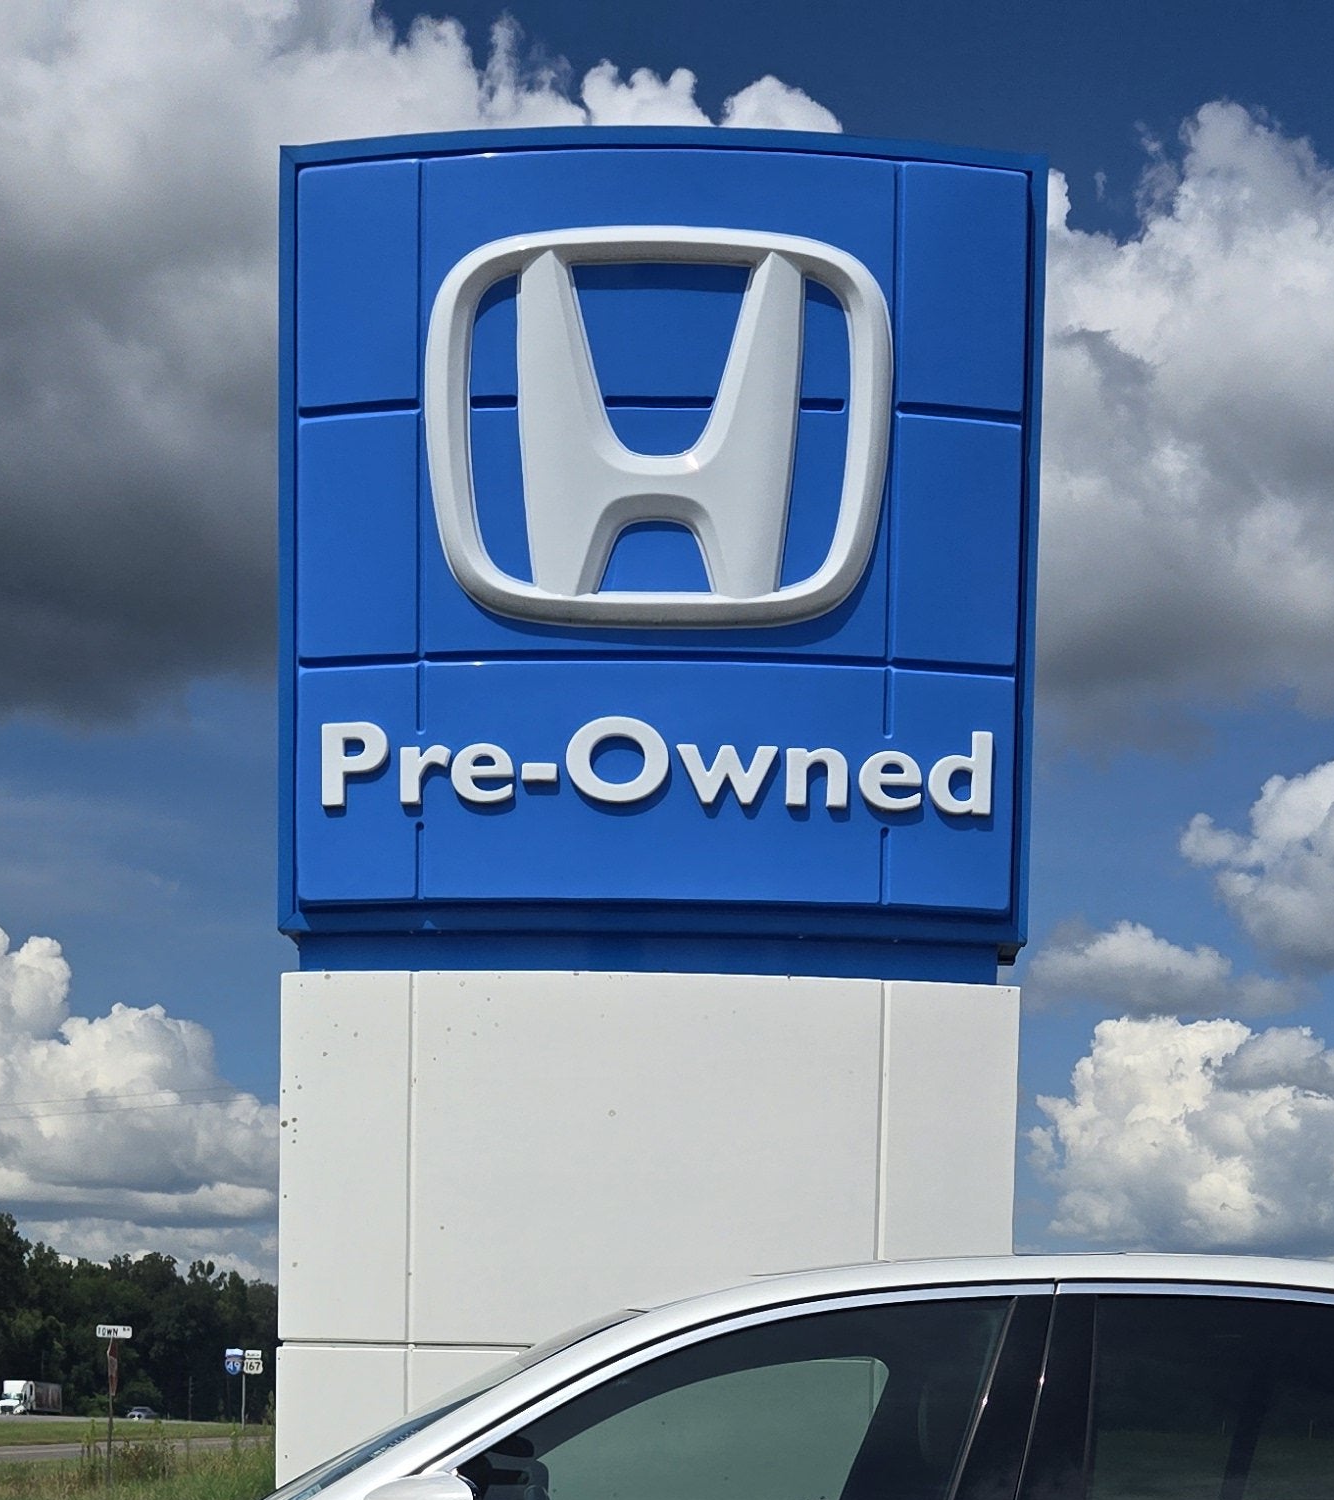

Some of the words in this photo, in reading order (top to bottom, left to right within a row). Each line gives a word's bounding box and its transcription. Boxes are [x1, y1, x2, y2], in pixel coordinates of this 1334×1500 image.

[321, 715, 994, 816] Pre-Owned
[227, 1360, 242, 1371] 49
[245, 1361, 261, 1371] 167
